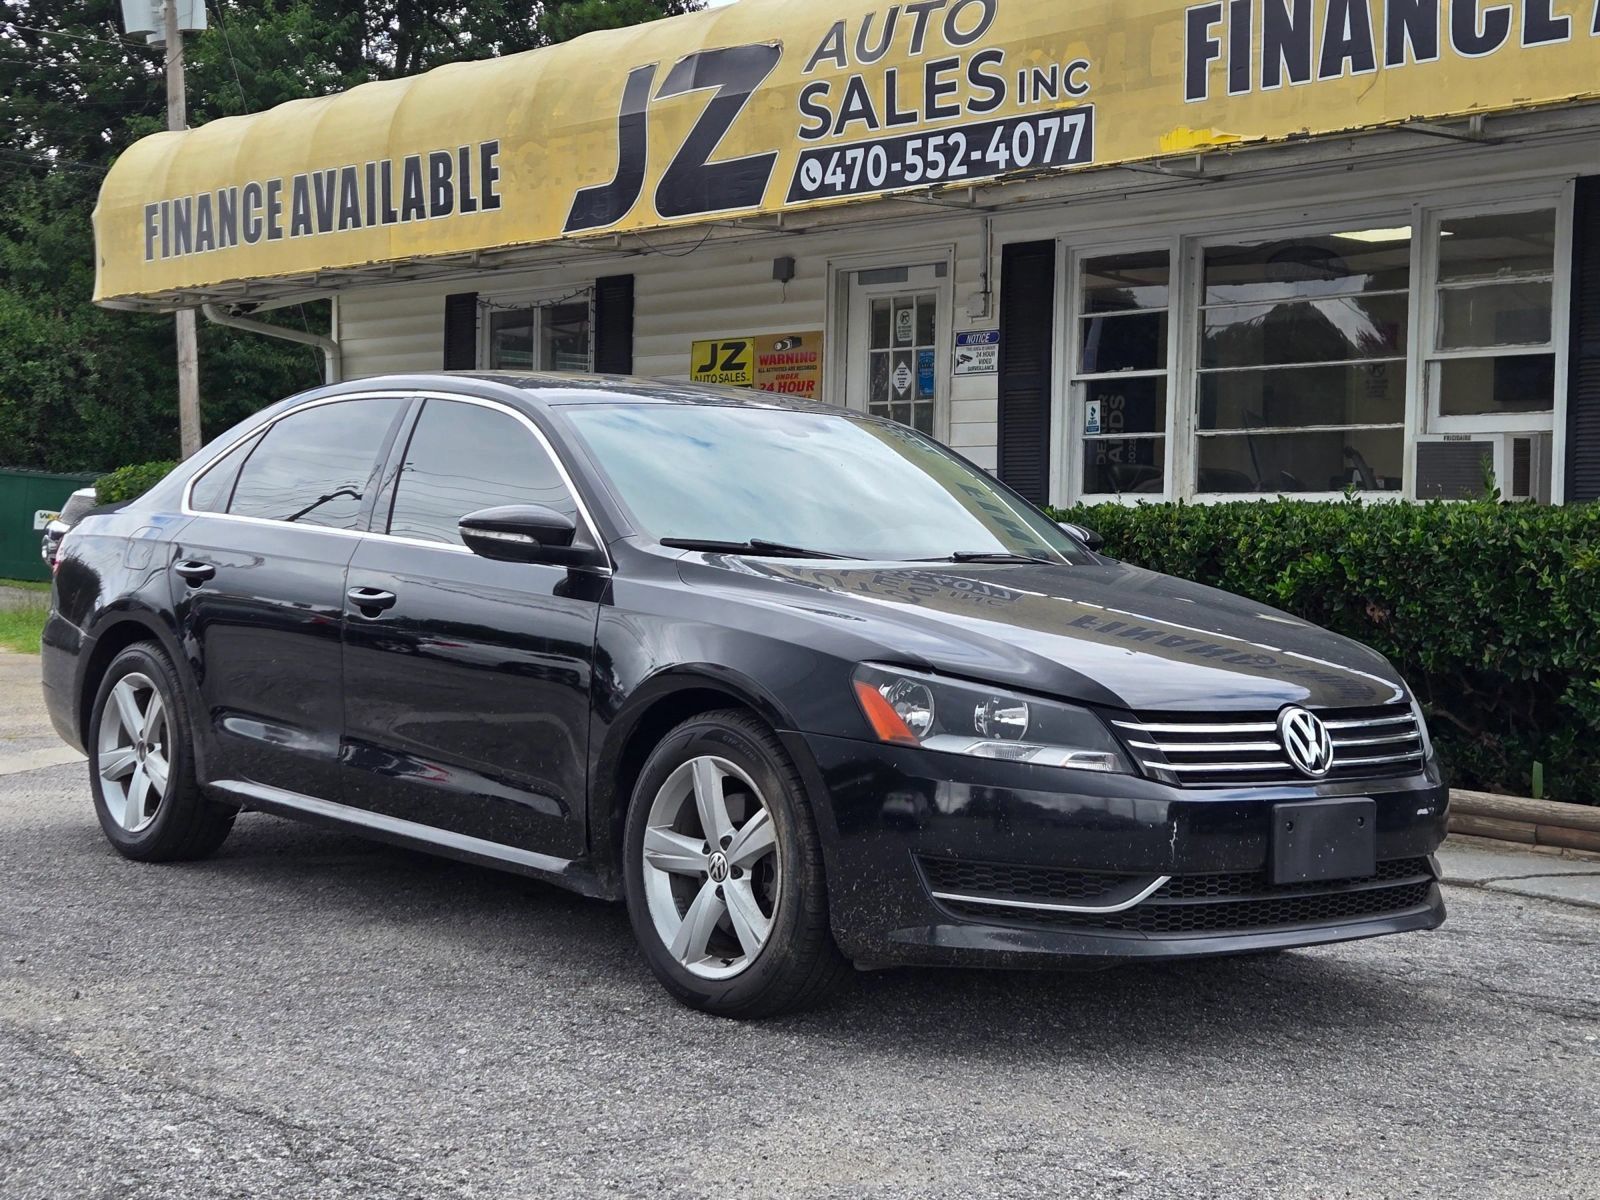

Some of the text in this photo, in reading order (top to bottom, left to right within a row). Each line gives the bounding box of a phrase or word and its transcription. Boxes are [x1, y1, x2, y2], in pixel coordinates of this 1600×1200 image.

[801, 0, 998, 74] AUTO
[797, 48, 1091, 141] SALES INC
[561, 39, 783, 234] JZ
[824, 113, 1086, 191] 470-552-4077
[144, 139, 501, 262] FINANCE AVAILABLE
[697, 341, 747, 373] JZ
[758, 351, 817, 366] WARNING
[966, 333, 990, 344] NOTICE
[719, 372, 746, 384] SALES
[778, 380, 816, 393] HOUR
